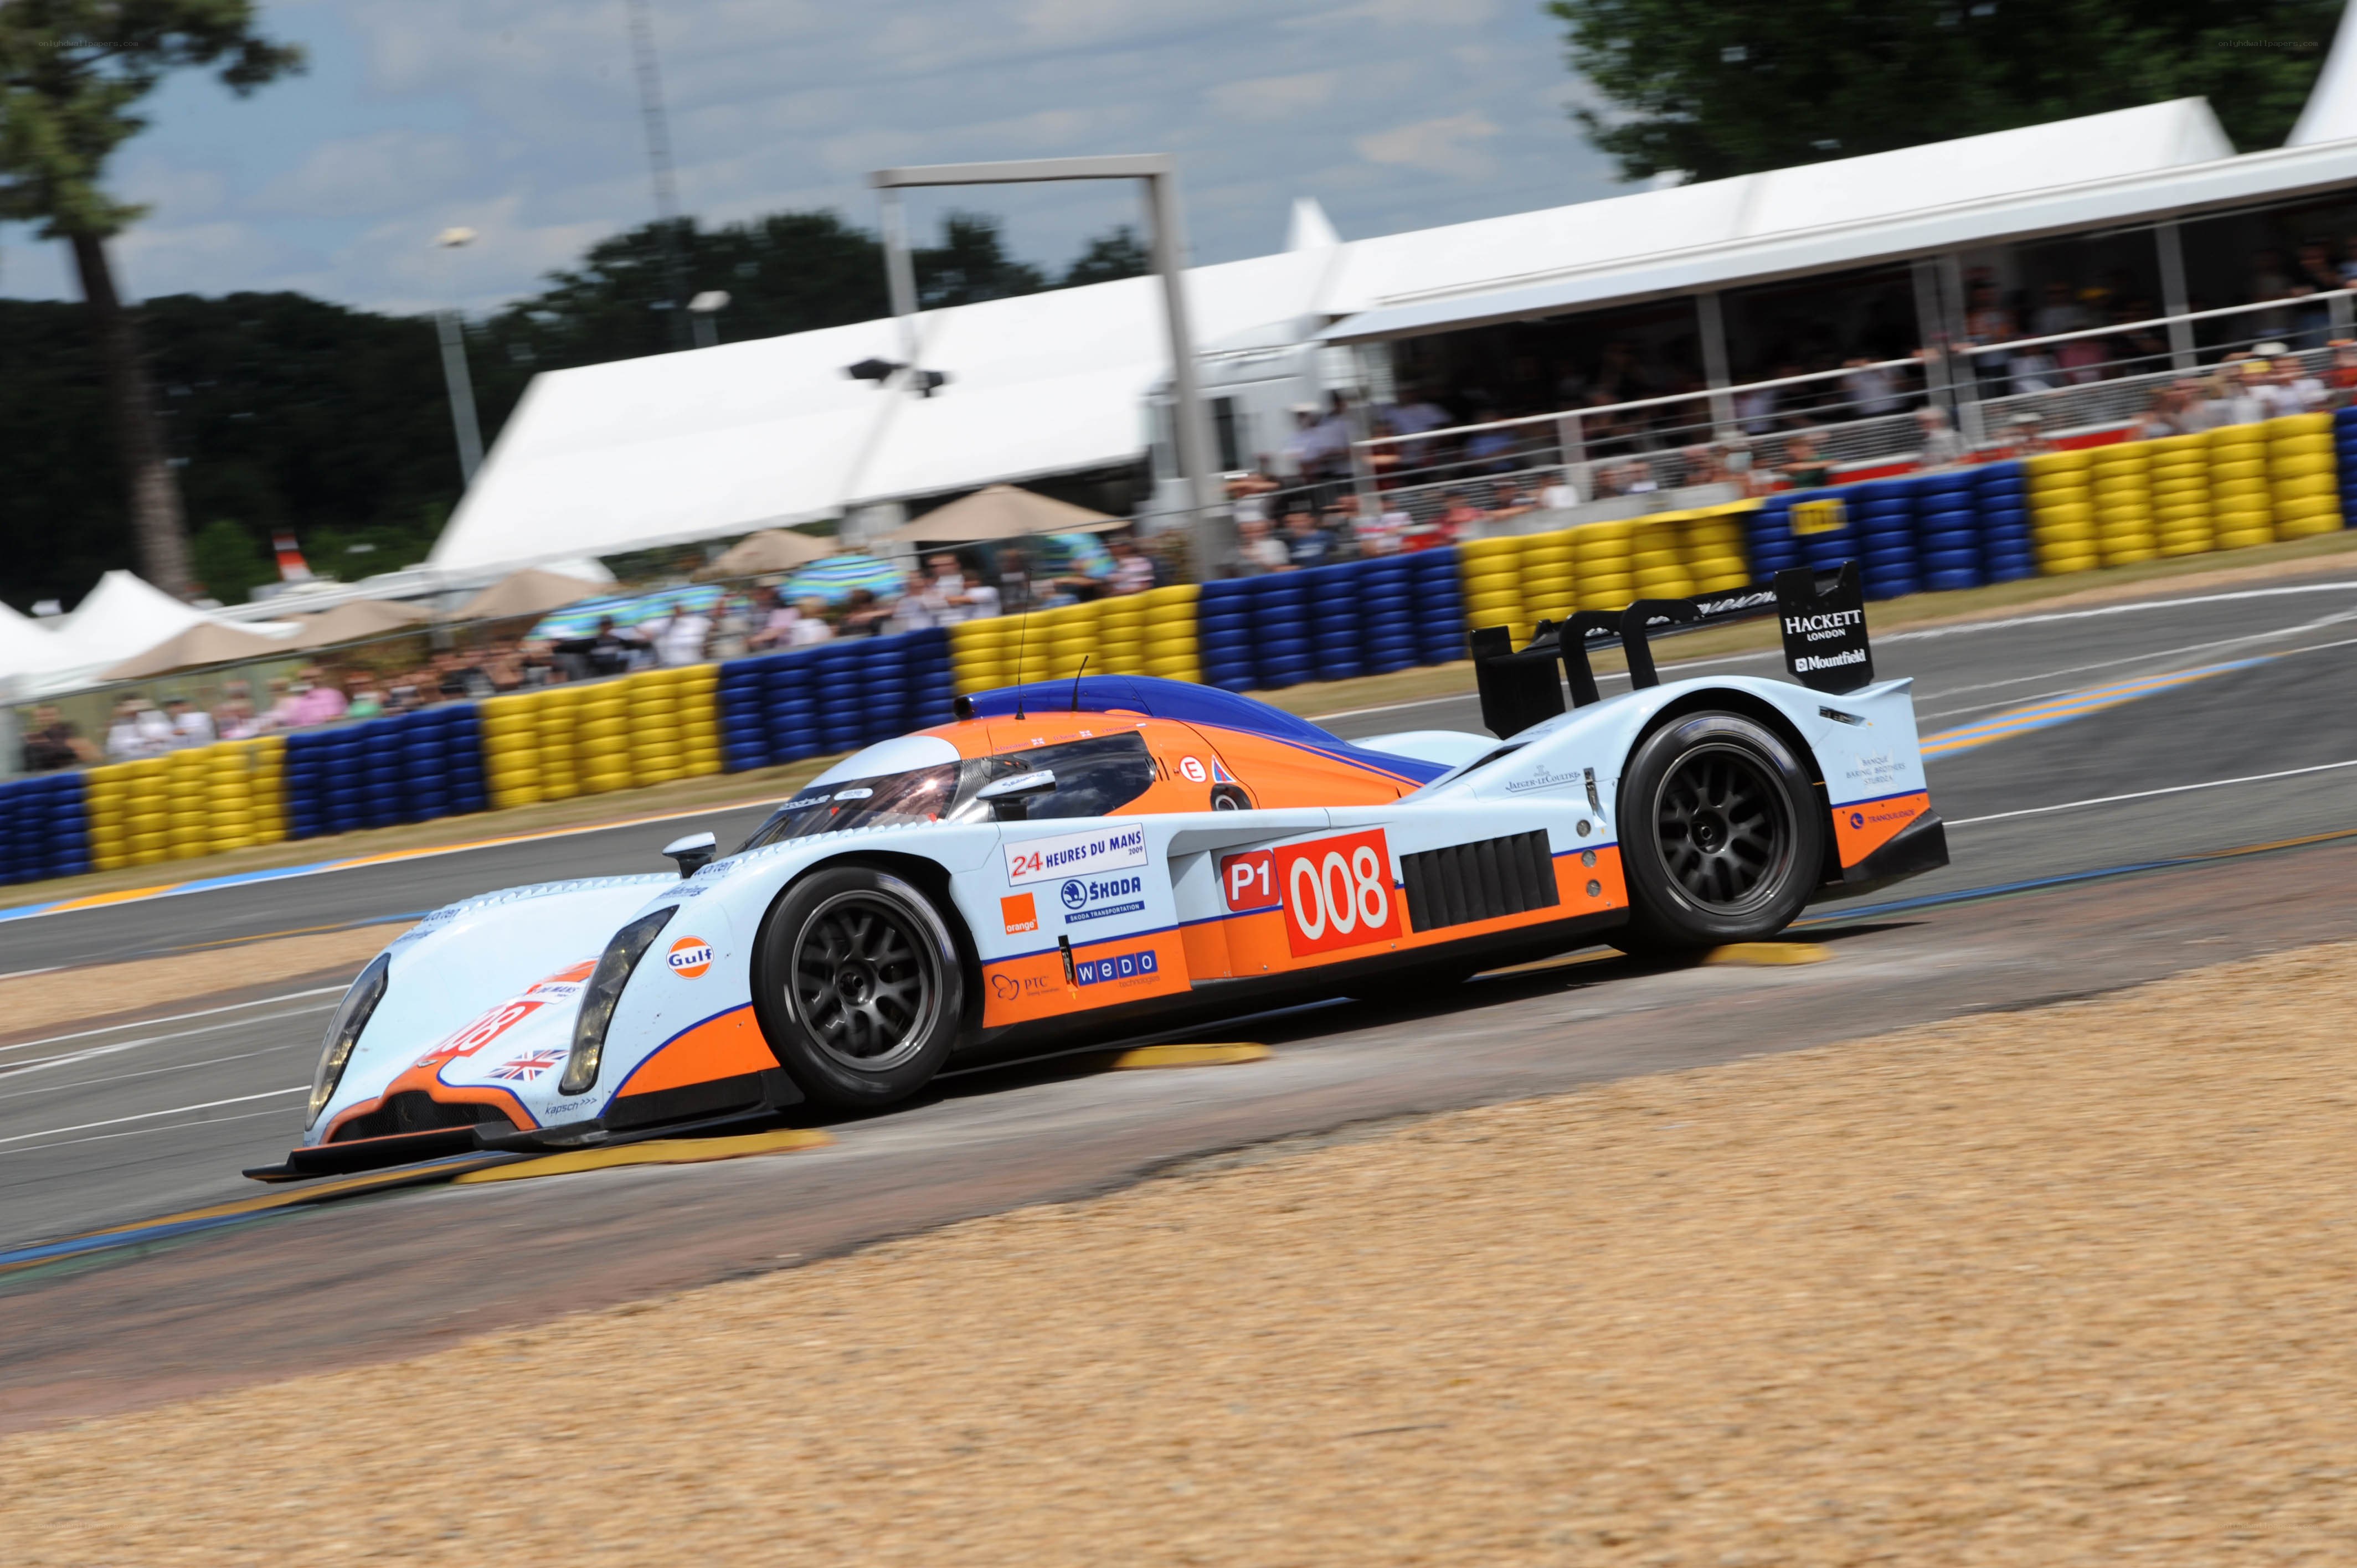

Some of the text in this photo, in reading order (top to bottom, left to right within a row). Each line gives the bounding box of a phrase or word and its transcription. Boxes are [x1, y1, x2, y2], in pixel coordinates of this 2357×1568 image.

[1785, 609, 1861, 634] HACKETT
[1807, 628, 1846, 641] LONDON
[1807, 648, 1866, 670] Mountfield
[1185, 762, 1202, 778] E
[1011, 831, 1141, 878] 24 HEURES DU MANS
[1129, 845, 1144, 855] 2009
[1089, 876, 1141, 900] ŠKODA
[1232, 859, 1270, 901] P1
[1290, 845, 1388, 940] 008
[1090, 904, 1140, 919] TRANSPORTATION
[1007, 921, 1035, 932] orange
[668, 948, 712, 966] Gulf
[1025, 976, 1048, 990] PTC
[544, 1102, 579, 1115] kapsch
